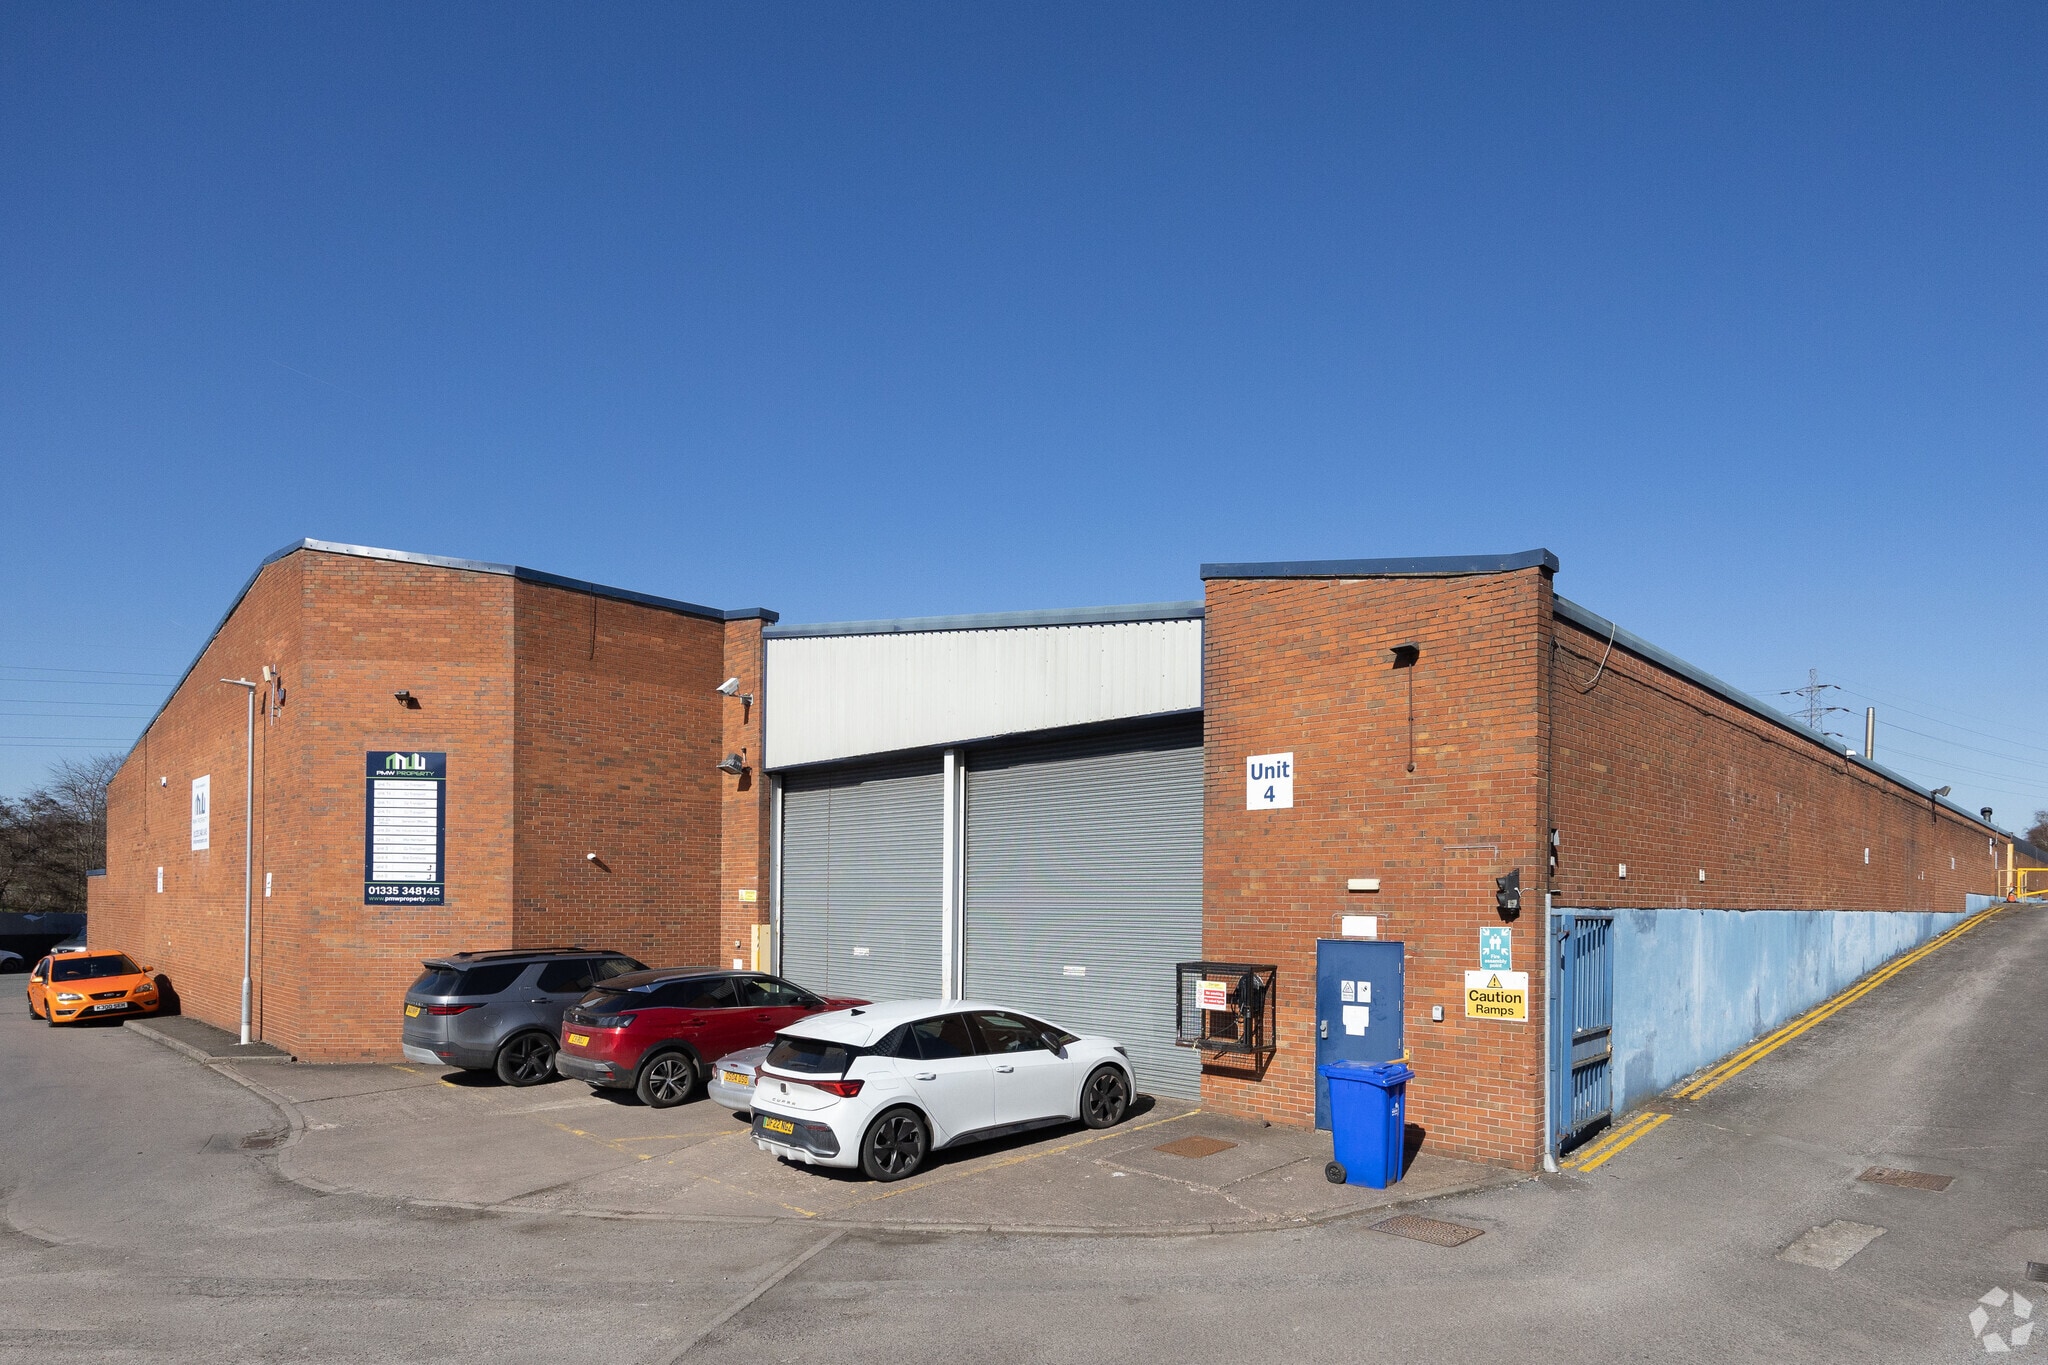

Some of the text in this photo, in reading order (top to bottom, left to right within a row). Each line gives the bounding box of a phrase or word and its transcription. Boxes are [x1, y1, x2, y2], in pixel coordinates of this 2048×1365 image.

[1251, 760, 1290, 780] Unit
[1263, 785, 1275, 802] 4
[368, 886, 440, 896] 01335 348145
[1469, 989, 1522, 1004] Caution
[1476, 1004, 1514, 1016] Ramps
